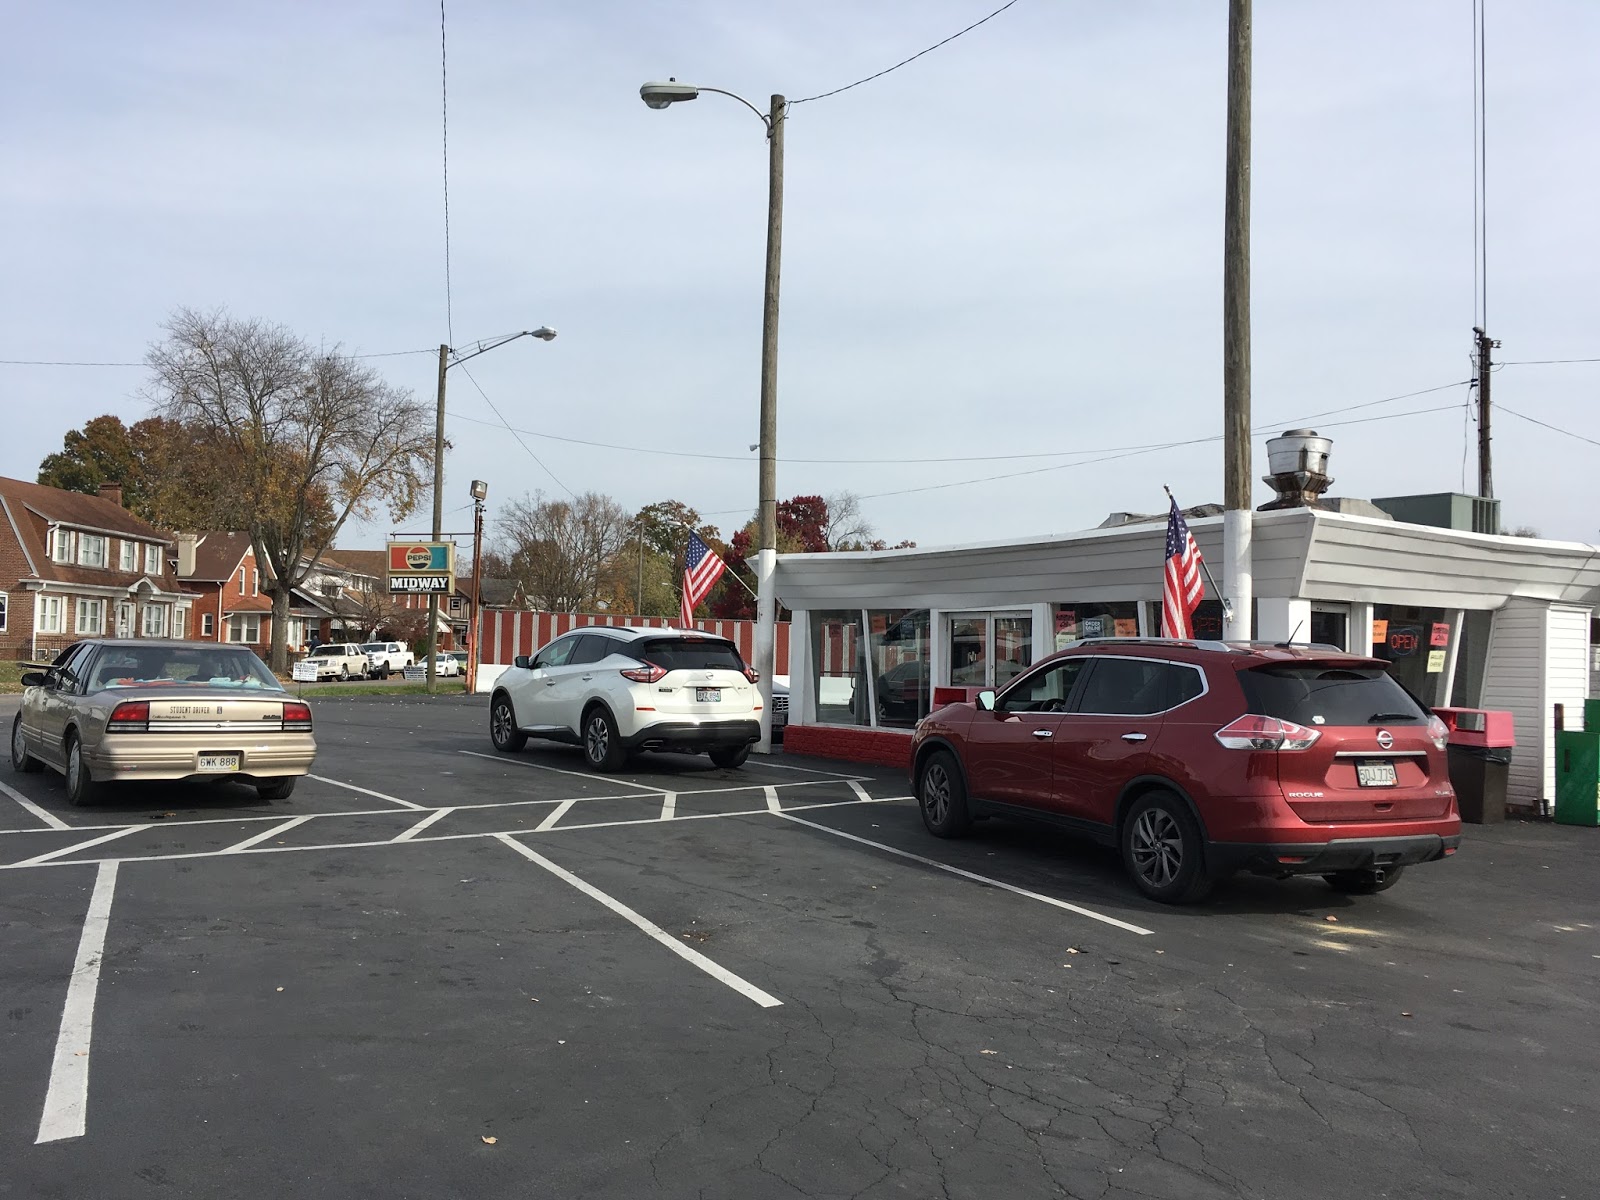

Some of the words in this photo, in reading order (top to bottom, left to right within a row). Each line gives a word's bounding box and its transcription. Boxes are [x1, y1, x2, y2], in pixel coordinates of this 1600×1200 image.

[390, 577, 448, 588] MIDWAY
[1391, 634, 1418, 649] OPEN
[200, 757, 216, 767] 6WK
[219, 757, 237, 766] 888
[1377, 768, 1395, 779] 779
